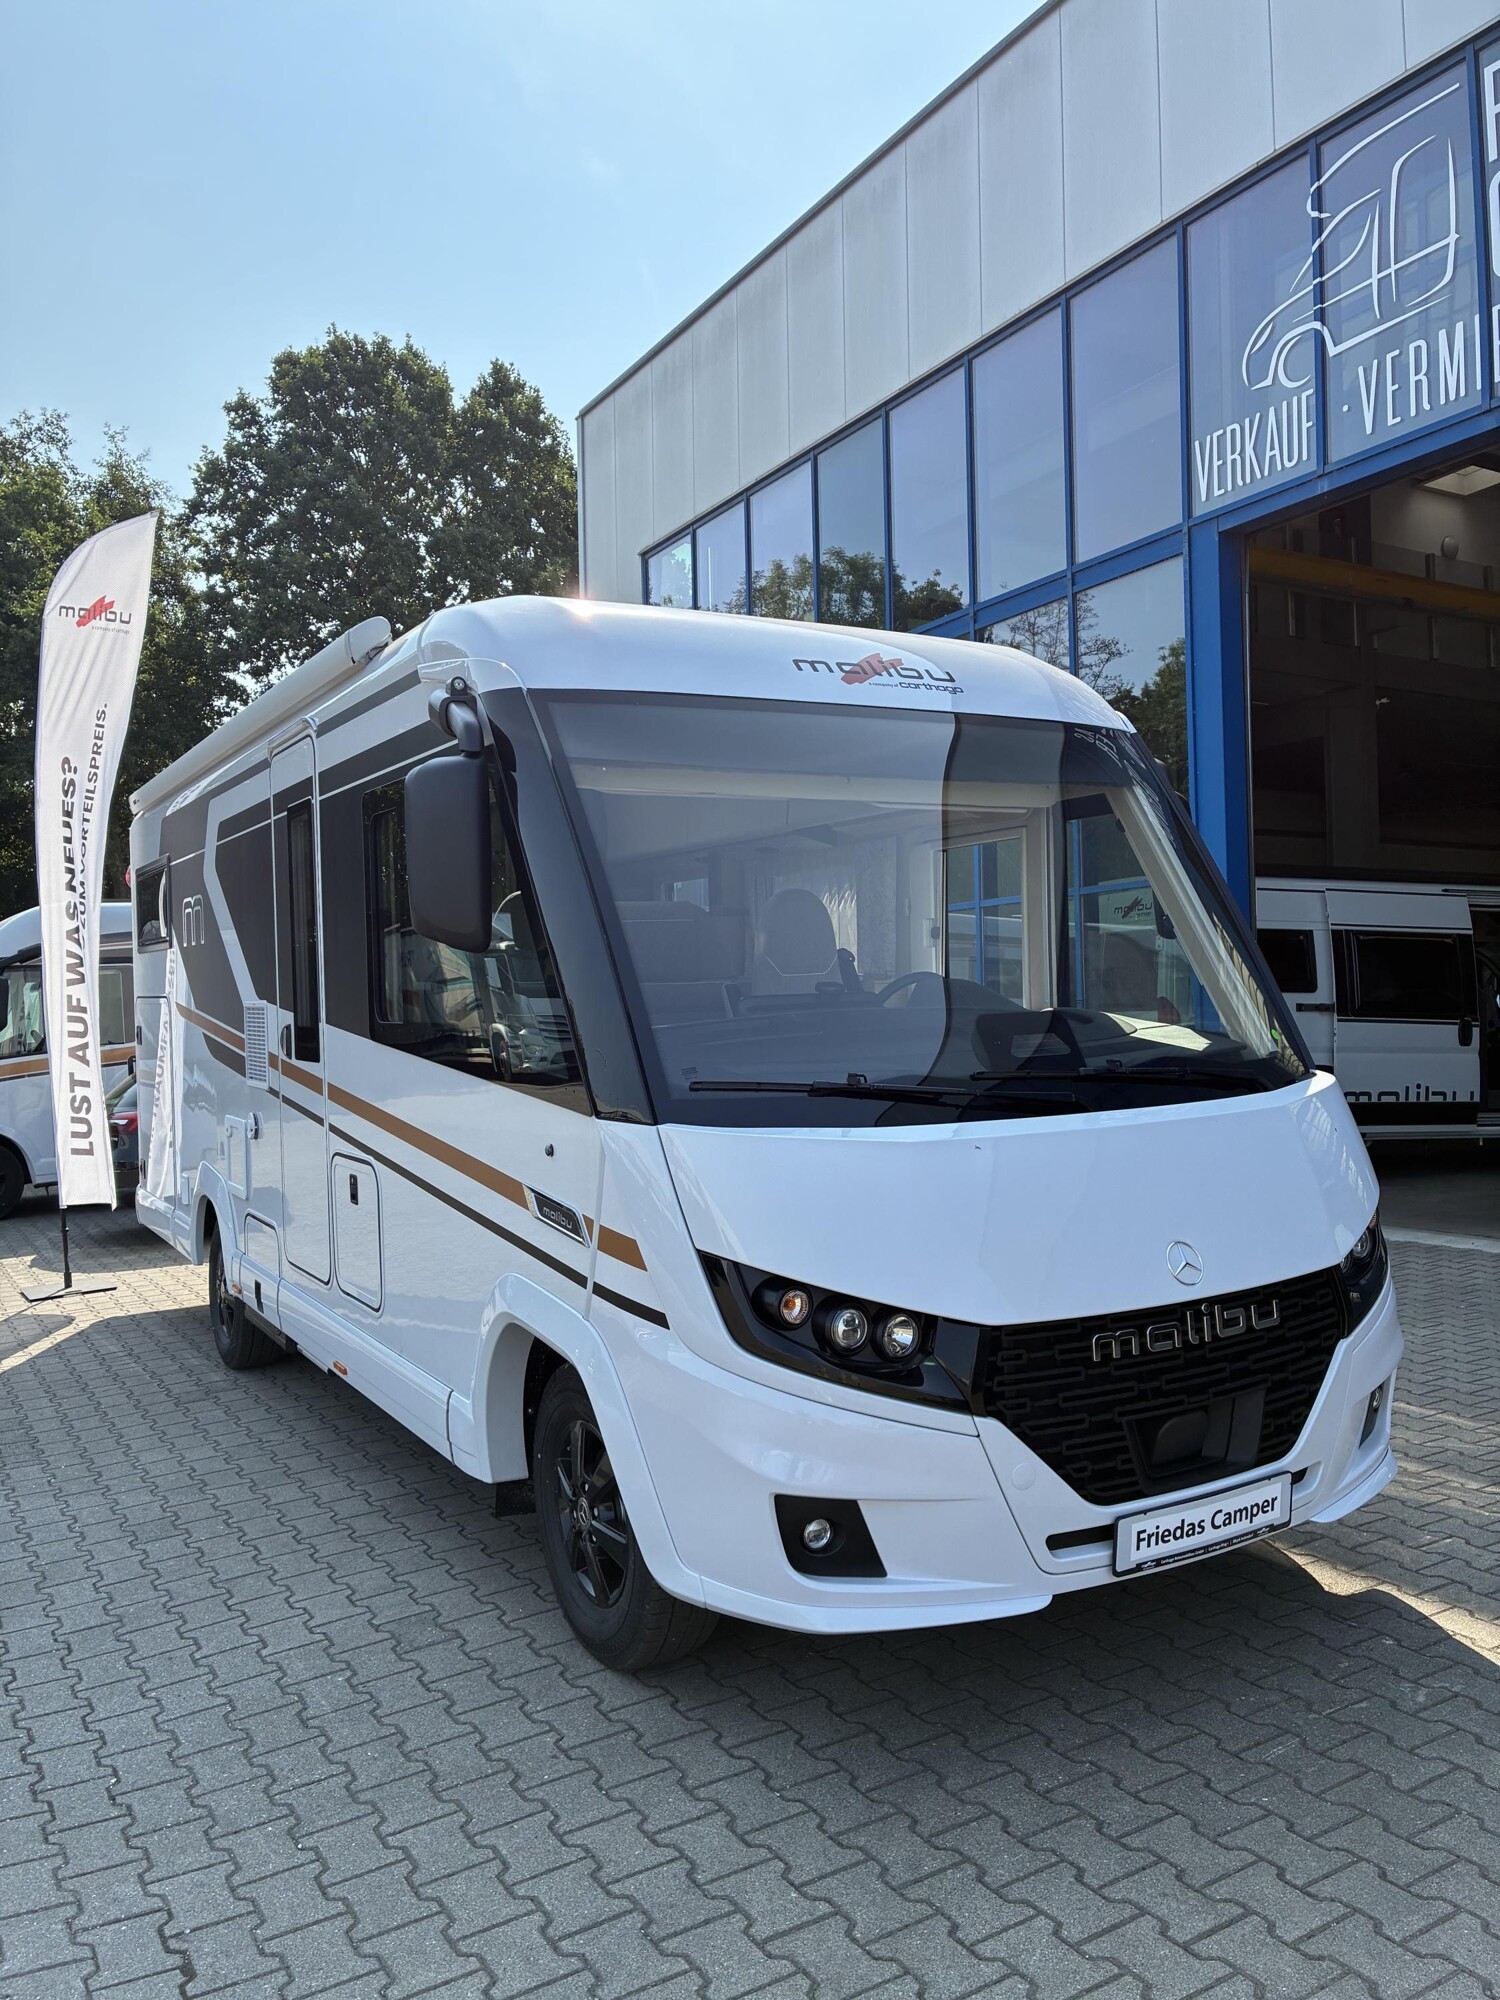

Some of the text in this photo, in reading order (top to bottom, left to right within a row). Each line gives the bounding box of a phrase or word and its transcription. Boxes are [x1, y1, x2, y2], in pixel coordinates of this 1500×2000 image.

[1194, 388, 1316, 502] VERKAUF
[59, 602, 132, 625] malibu
[792, 658, 956, 683] malibu
[898, 682, 965, 695] carthago
[80, 702, 108, 875] VORTEILSPREIS.
[61, 755, 94, 1157] LUST AUF WAS NEUES?
[542, 1206, 573, 1229] malibu
[1092, 1299, 1281, 1362] malibu
[1136, 1517, 1206, 1552] Friedas
[1210, 1495, 1279, 1533] Camper
